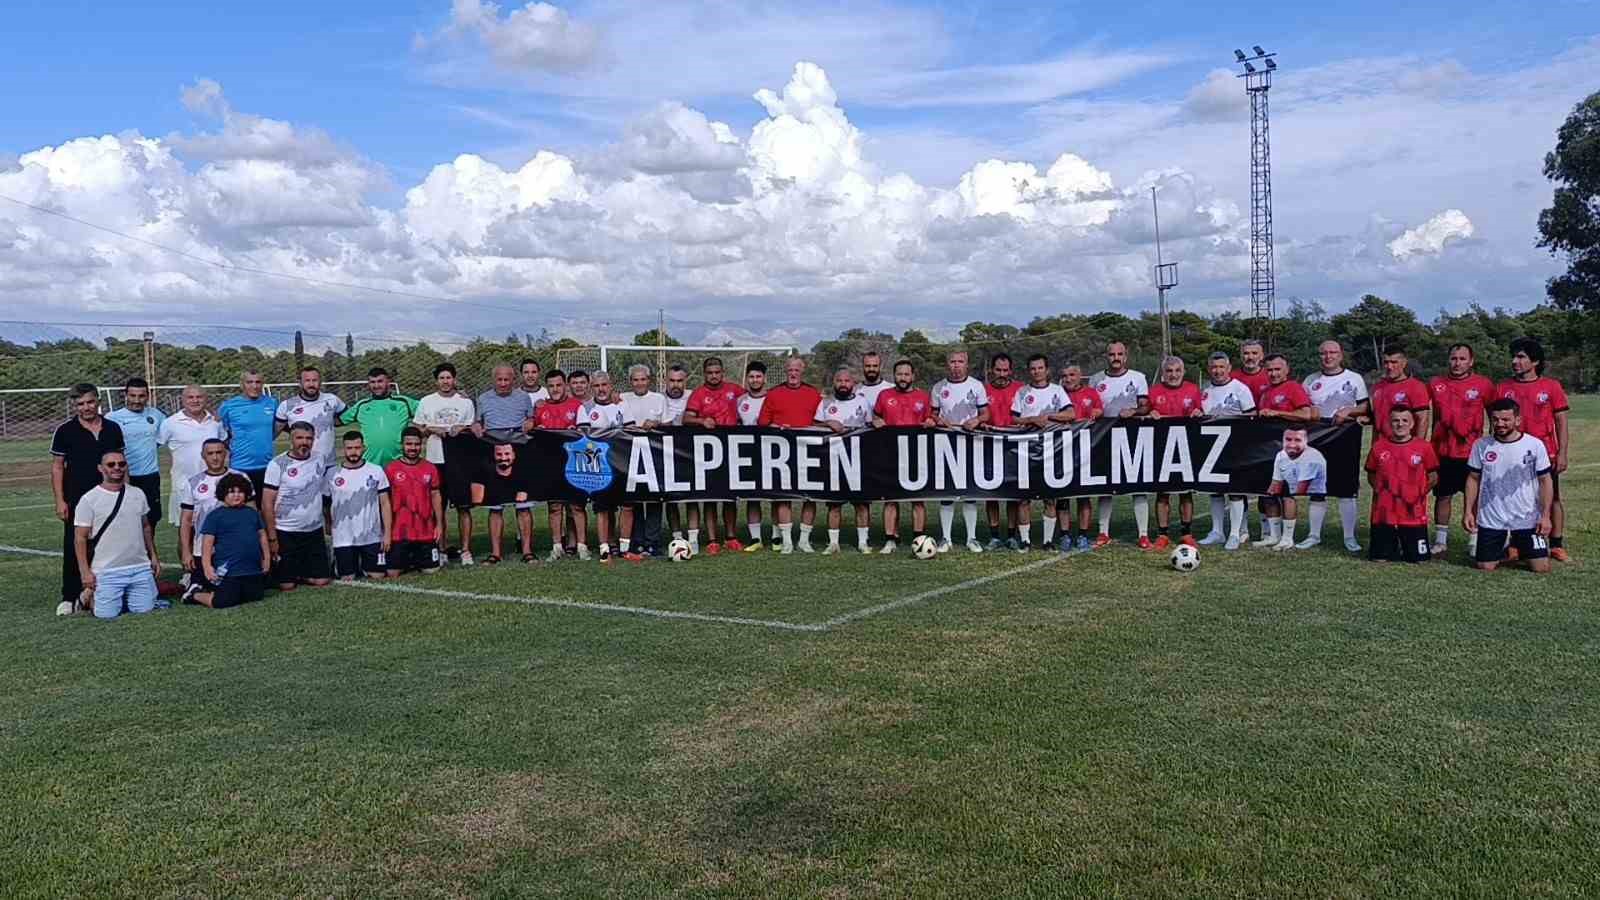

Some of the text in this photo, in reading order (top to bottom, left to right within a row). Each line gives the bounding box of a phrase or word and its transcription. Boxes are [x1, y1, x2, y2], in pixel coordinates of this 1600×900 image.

[625, 426, 1231, 492] ALPEREN UNUTULMAZ
[1417, 539, 1427, 554] 6
